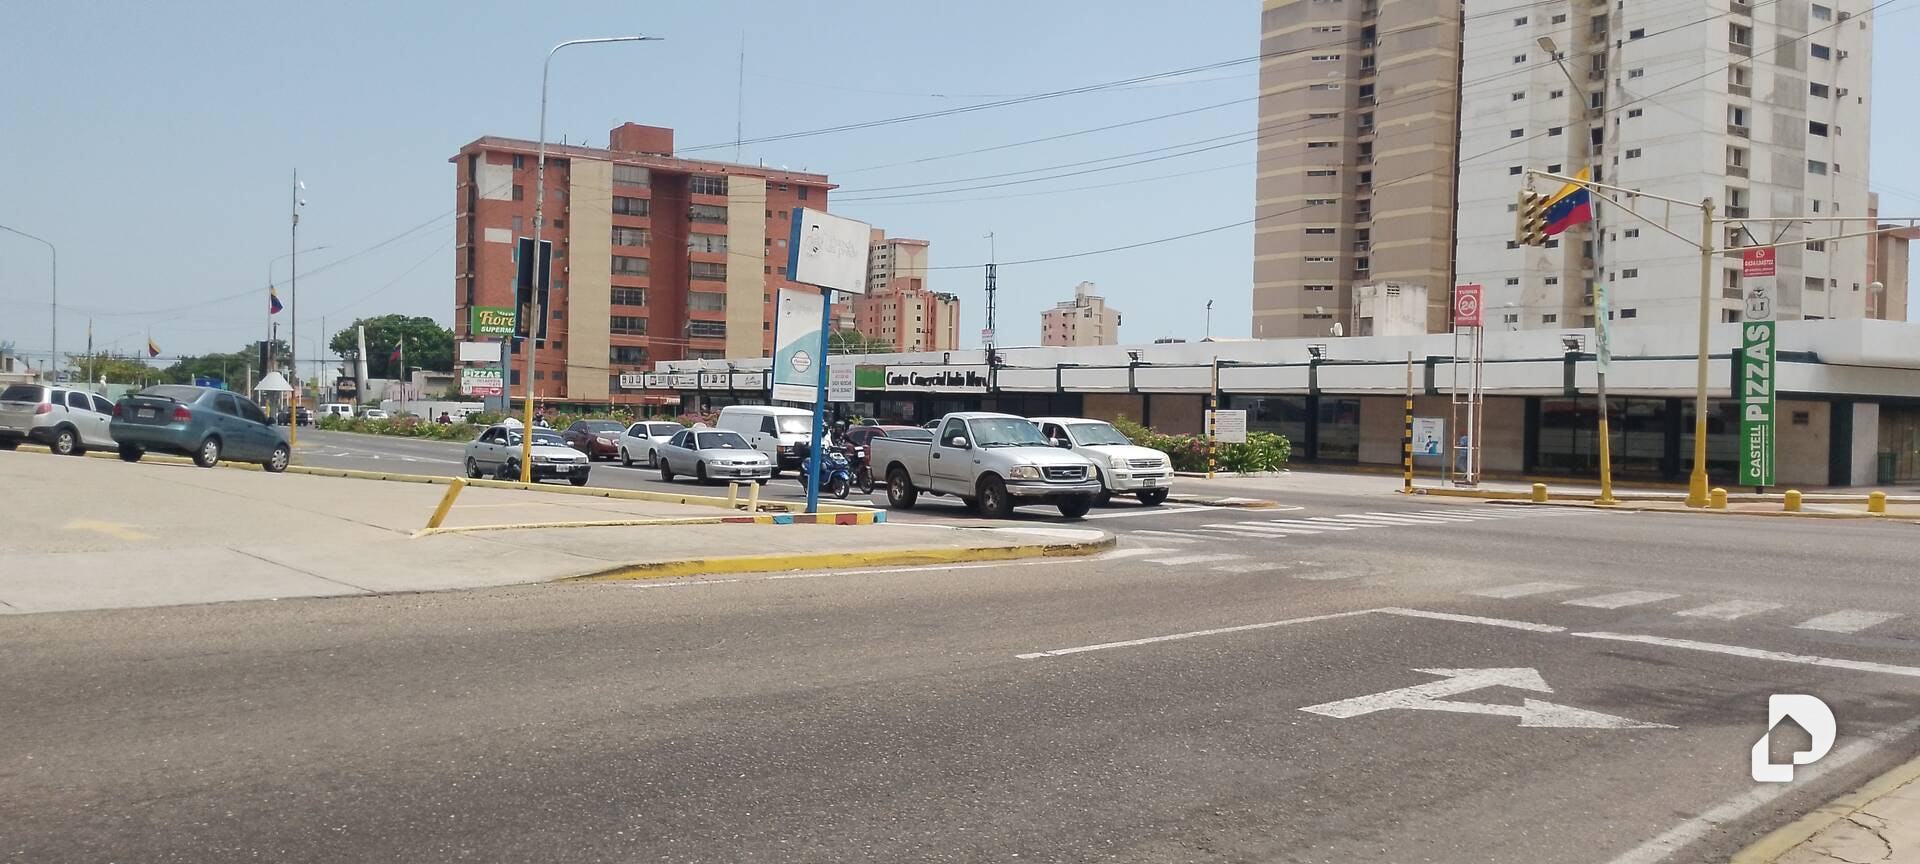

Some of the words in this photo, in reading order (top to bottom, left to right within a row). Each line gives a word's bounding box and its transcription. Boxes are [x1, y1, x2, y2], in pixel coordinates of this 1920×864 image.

[1461, 300, 1475, 310] 24
[463, 370, 501, 378] PIZZAS
[1746, 324, 1770, 421] PIZZAS
[1751, 425, 1762, 478] CASTELL
